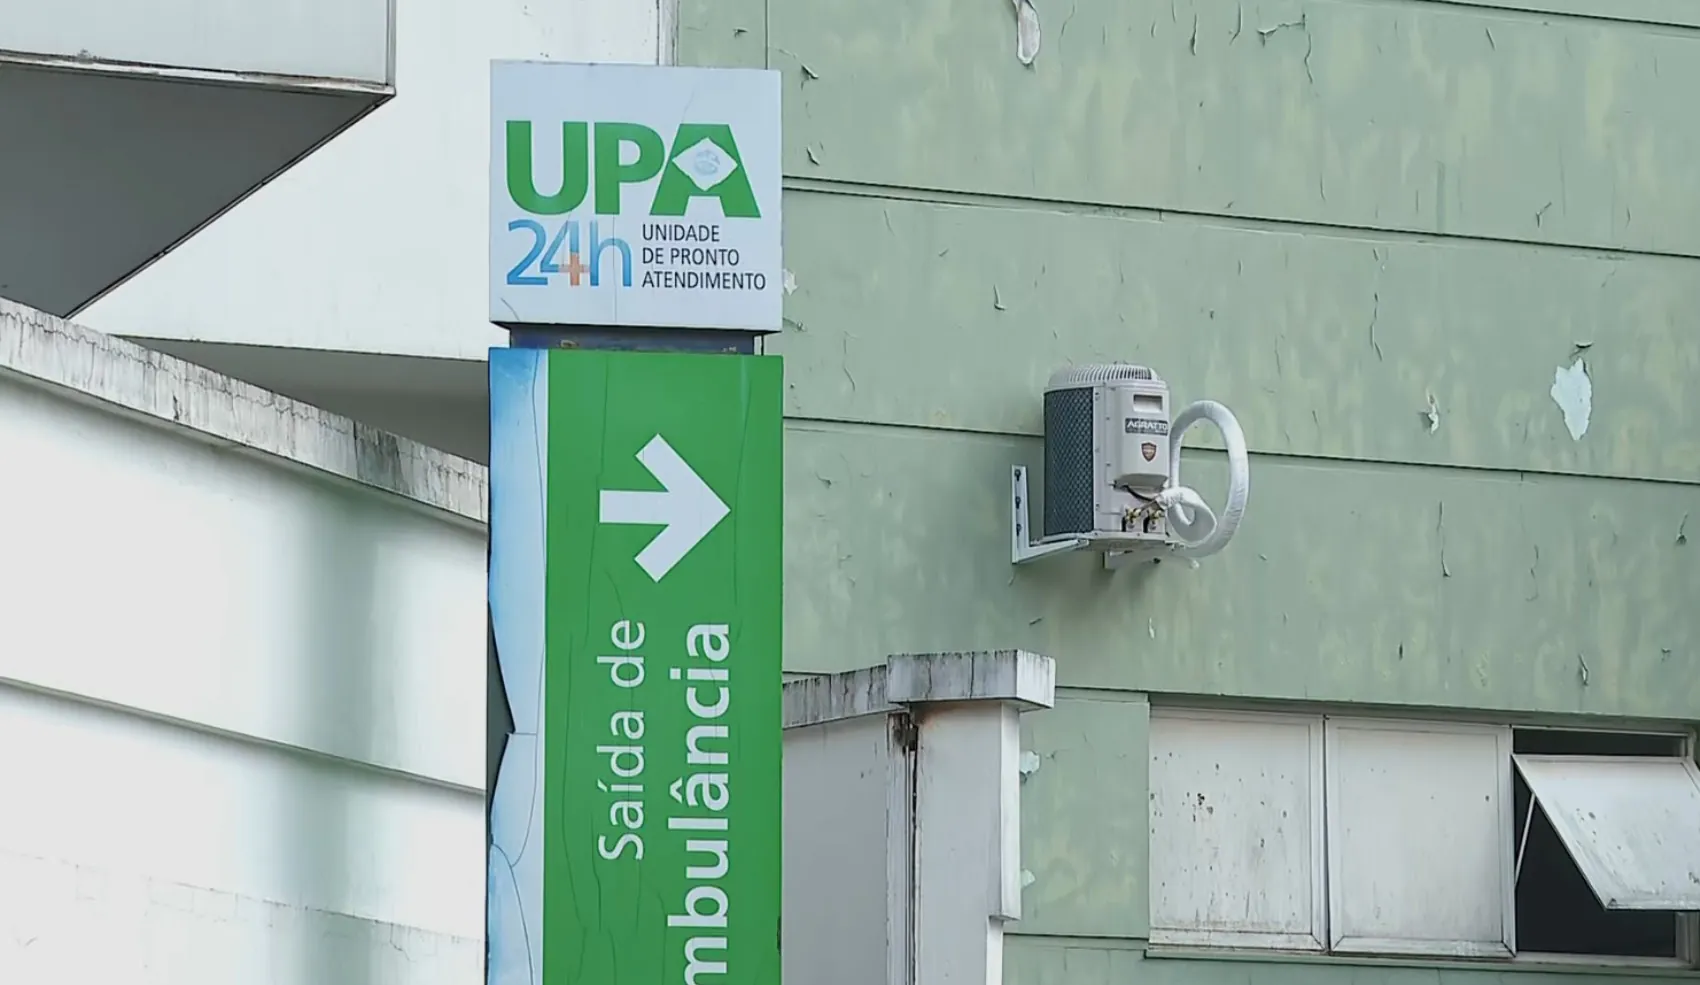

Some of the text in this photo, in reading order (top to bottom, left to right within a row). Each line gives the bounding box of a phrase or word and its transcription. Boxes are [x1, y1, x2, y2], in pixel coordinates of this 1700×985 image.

[506, 120, 761, 217] UPA
[642, 224, 720, 242] UNIDADE
[506, 219, 631, 286] 24h
[642, 248, 739, 266] DE PRONTO
[641, 271, 766, 290] ATENDIMENTO
[1127, 420, 1167, 429] AGRATTO
[596, 619, 645, 861] Saída de
